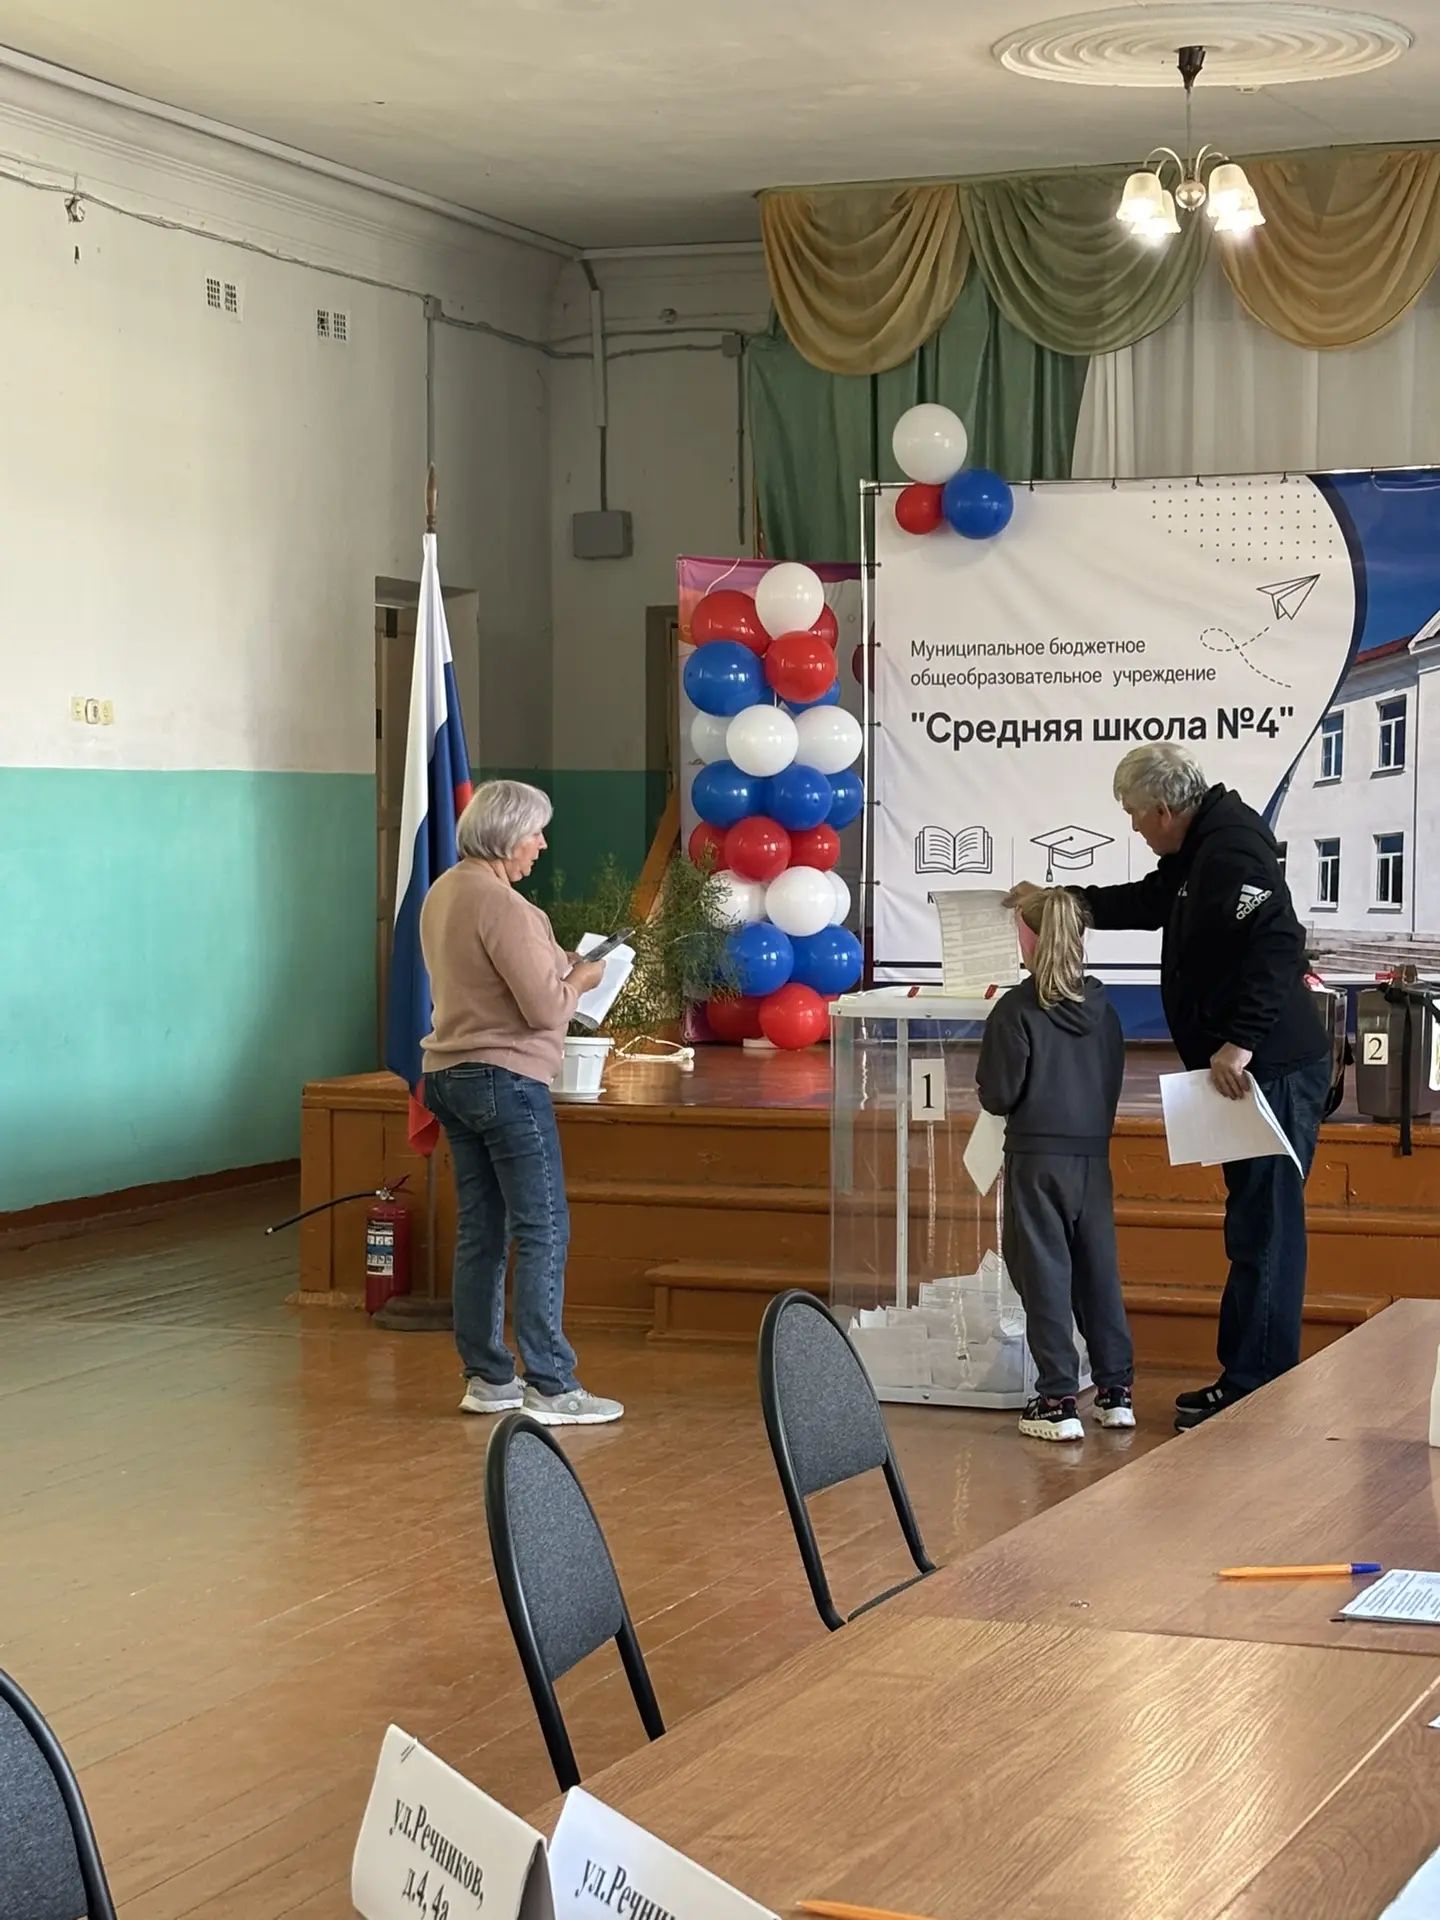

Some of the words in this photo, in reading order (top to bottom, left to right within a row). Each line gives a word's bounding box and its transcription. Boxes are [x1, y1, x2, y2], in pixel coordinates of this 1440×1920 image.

[911, 640, 1045, 661] Муниципальное
[1049, 637, 1146, 656] бюджетное
[910, 667, 1102, 689] общеобразовательное
[1113, 667, 1217, 687] учреждение
[911, 711, 1083, 751] "Средняя
[1092, 716, 1207, 742] школа
[1216, 706, 1294, 740] №4"
[1236, 890, 1272, 920] adidas
[1368, 1037, 1384, 1061] 2
[921, 1072, 935, 1109] 1
[388, 1798, 484, 1912] ул.Речников,
